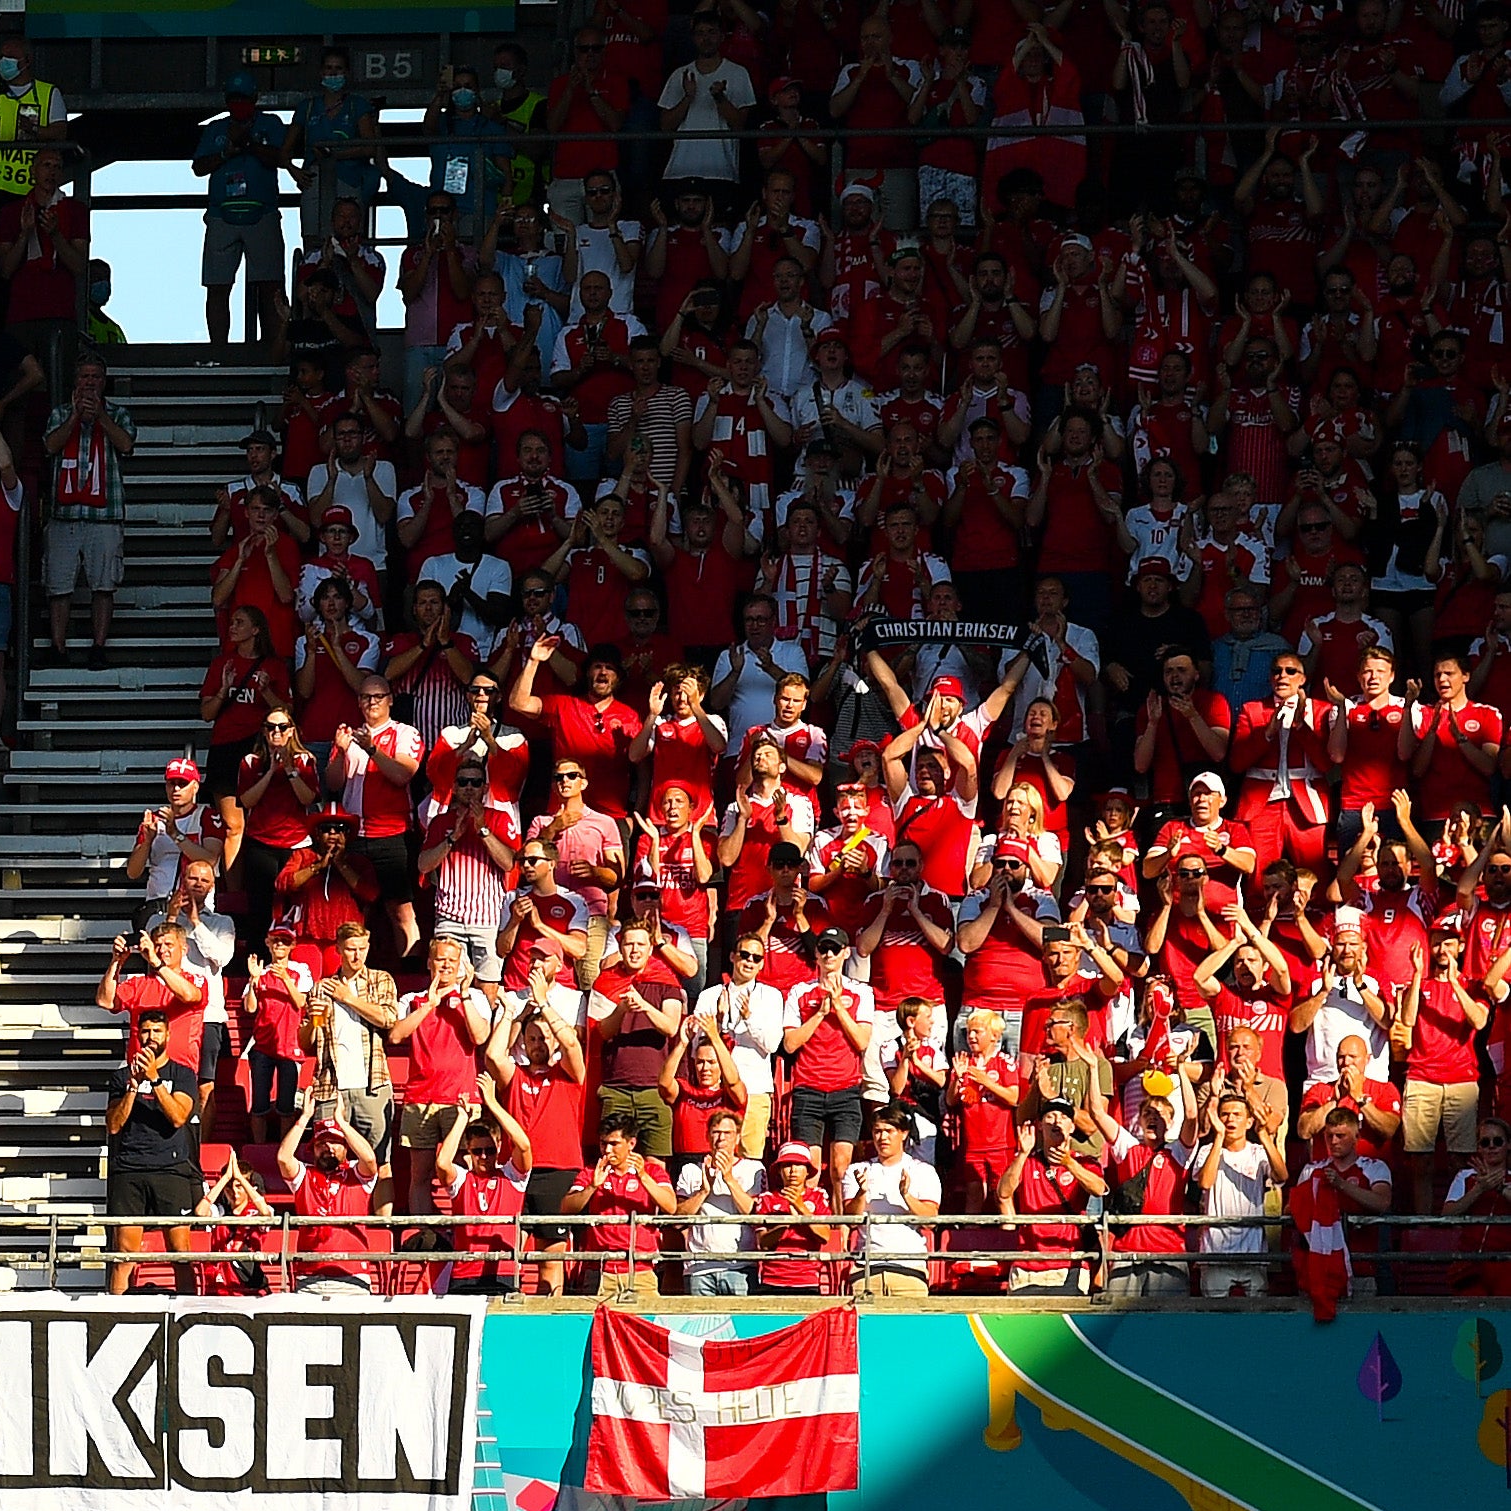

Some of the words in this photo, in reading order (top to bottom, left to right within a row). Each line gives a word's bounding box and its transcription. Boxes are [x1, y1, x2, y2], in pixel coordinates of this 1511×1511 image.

[365, 53, 413, 79] B5
[736, 416, 746, 436] 4
[1151, 529, 1164, 545] 10
[597, 566, 605, 584] 8
[875, 620, 952, 640] CHRISTIAN
[955, 622, 1019, 640] ERIKSEN
[1383, 909, 1395, 924] 9
